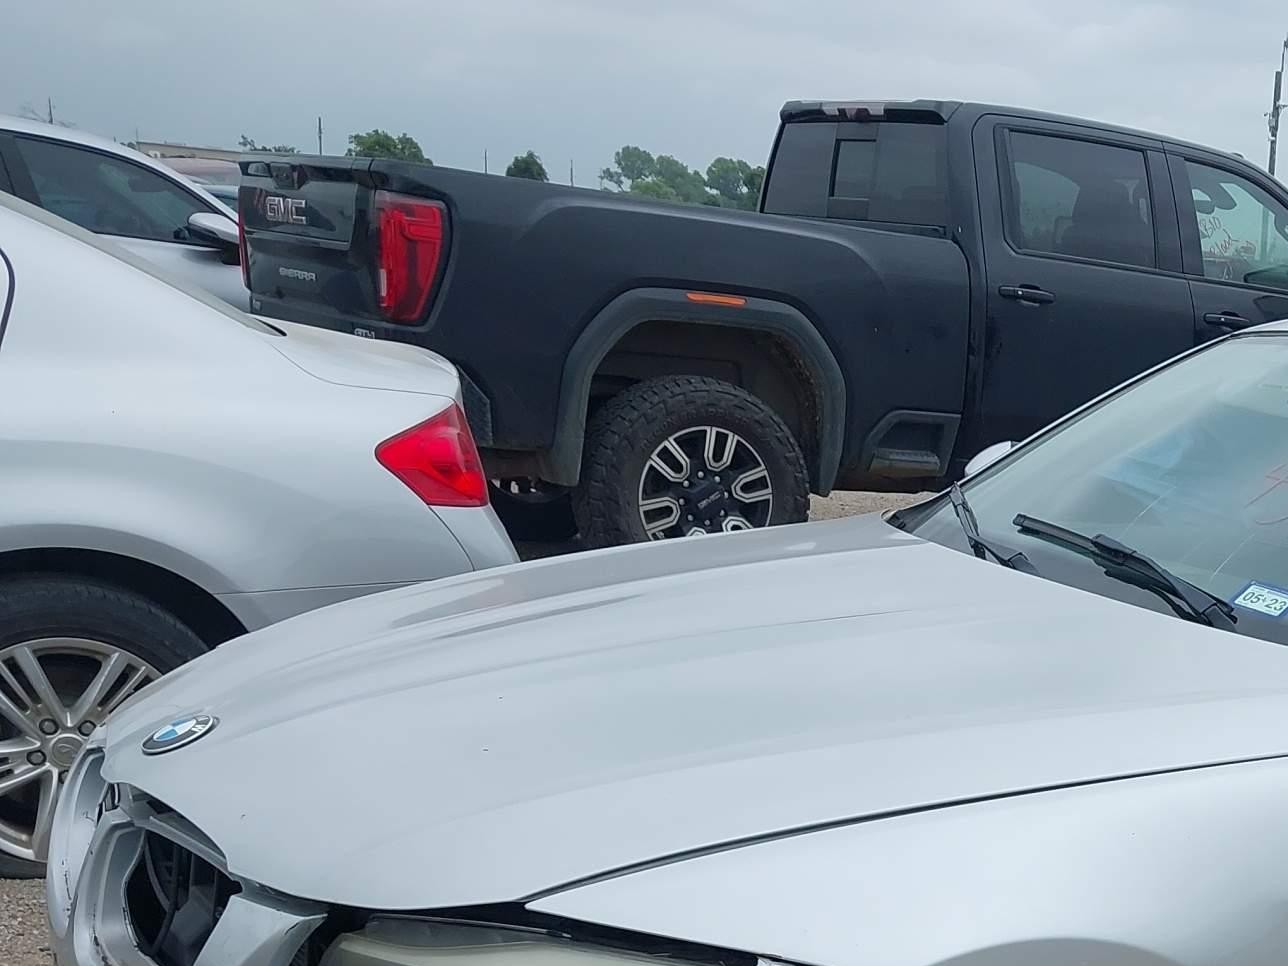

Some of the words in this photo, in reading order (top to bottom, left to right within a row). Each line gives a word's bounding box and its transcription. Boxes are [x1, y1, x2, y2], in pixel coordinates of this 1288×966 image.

[266, 196, 307, 225] GMC
[1242, 591, 1265, 604] 05
[1264, 598, 1287, 611] 23
